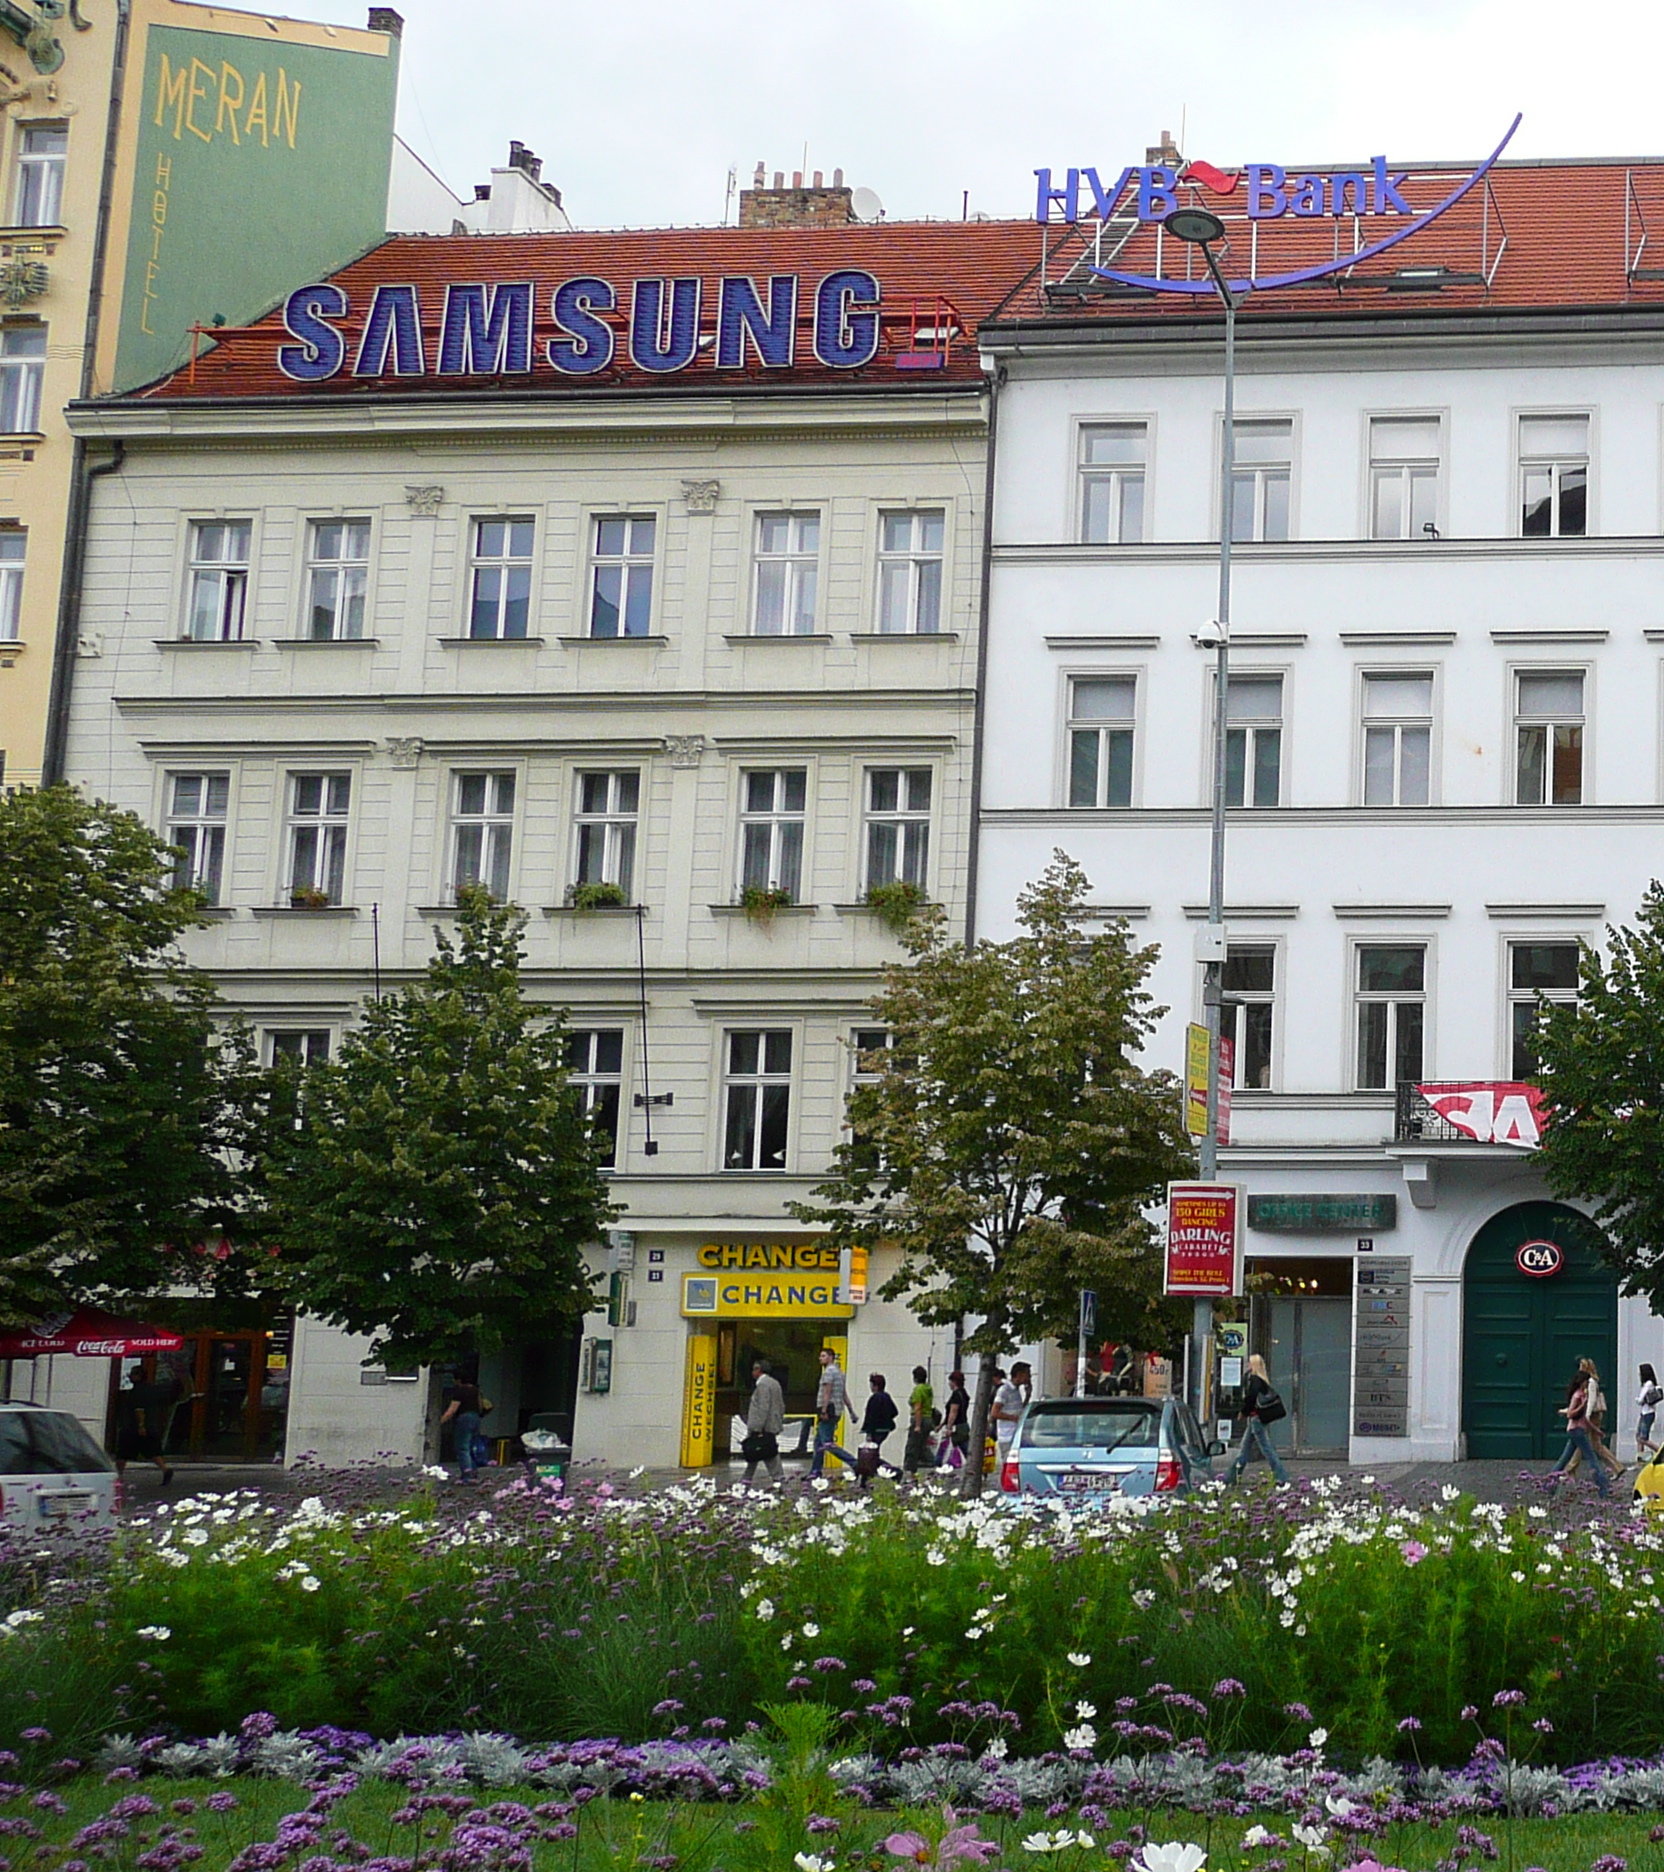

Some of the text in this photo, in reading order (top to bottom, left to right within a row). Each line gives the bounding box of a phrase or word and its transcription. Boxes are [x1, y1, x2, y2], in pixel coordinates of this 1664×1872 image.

[154, 52, 302, 150] MERAN
[1033, 155, 1412, 225] HVB Bank
[140, 151, 173, 336] HOTEL
[276, 269, 884, 383] SAMSUNG
[1194, 1208, 1226, 1218] GIRLS
[1258, 1203, 1384, 1219] OFFICE CENTER
[1181, 1218, 1218, 1227] DANCING
[1170, 1228, 1232, 1245] DARLING
[697, 1244, 839, 1268] CHANGE
[1523, 1249, 1554, 1267] C&A
[131, 1339, 155, 1347] SOLD
[692, 1362, 706, 1440] CHANGE
